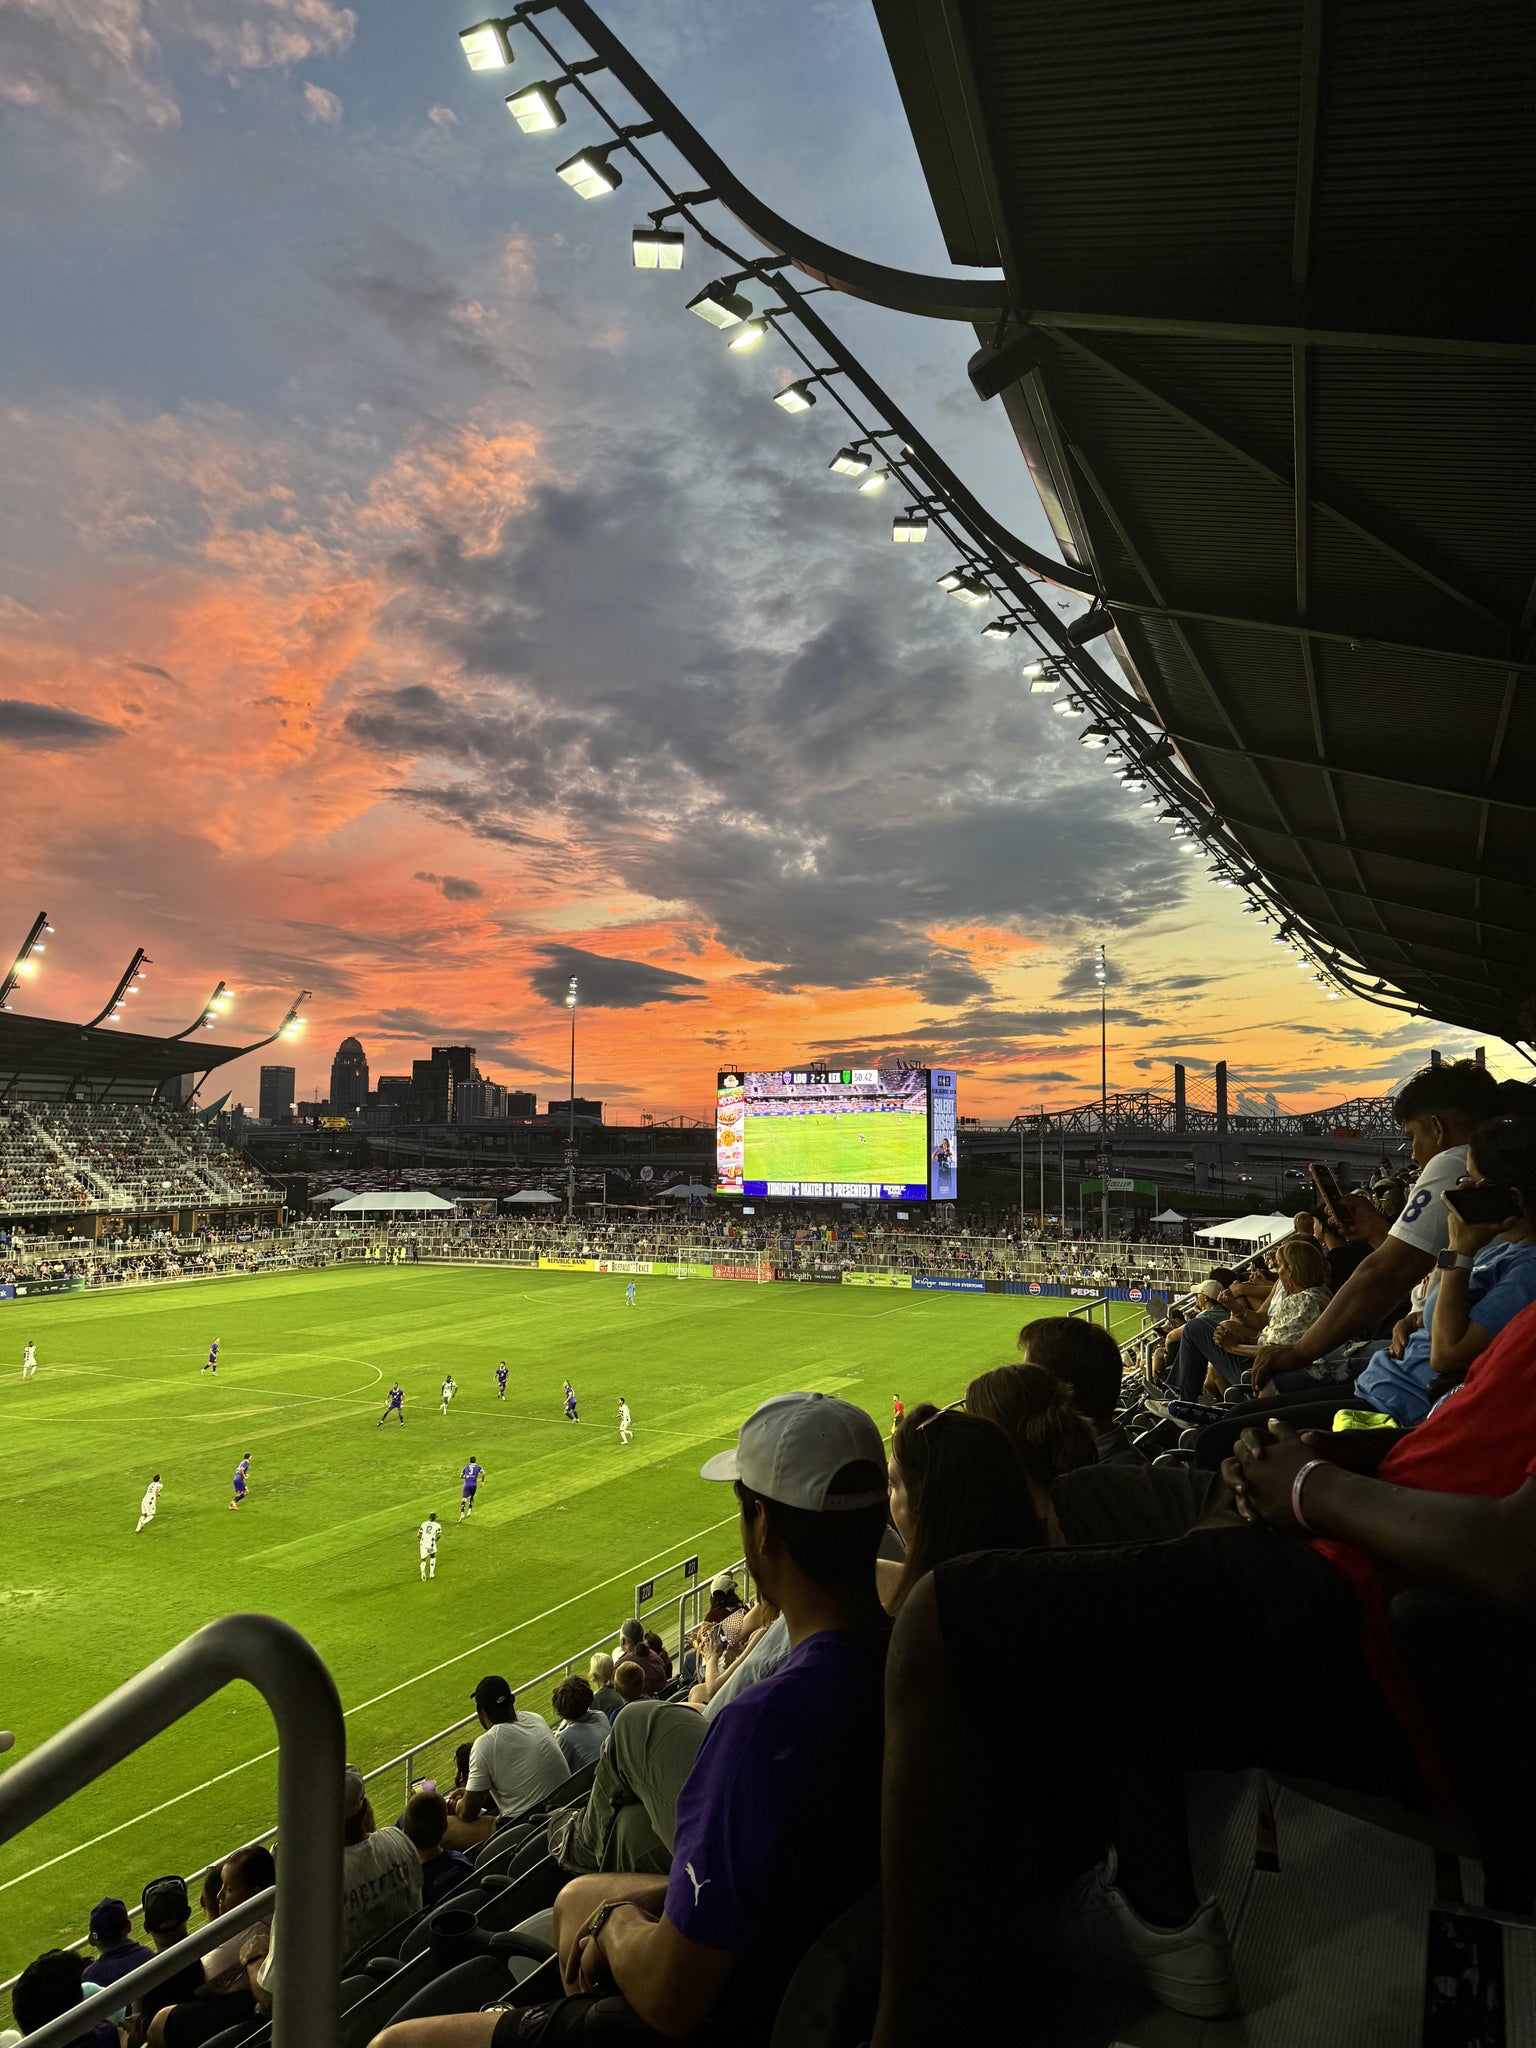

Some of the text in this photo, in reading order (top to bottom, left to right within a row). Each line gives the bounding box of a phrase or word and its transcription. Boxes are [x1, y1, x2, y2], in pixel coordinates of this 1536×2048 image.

[933, 1098, 955, 1114] SILENT
[934, 1114, 955, 1130] DISCO
[767, 1182, 882, 1198] TONIGHT'S MATCH IS PRESENTED BY
[1402, 1190, 1432, 1222] 8
[571, 1258, 587, 1266] BANK
[611, 1261, 650, 1273] BUFFALO TRACE
[722, 1265, 765, 1275] JEFFERSON
[777, 1270, 812, 1281] UL Health
[1071, 1287, 1099, 1297] PEPSI
[468, 1467, 474, 1475] 3
[426, 1525, 433, 1535] 12
